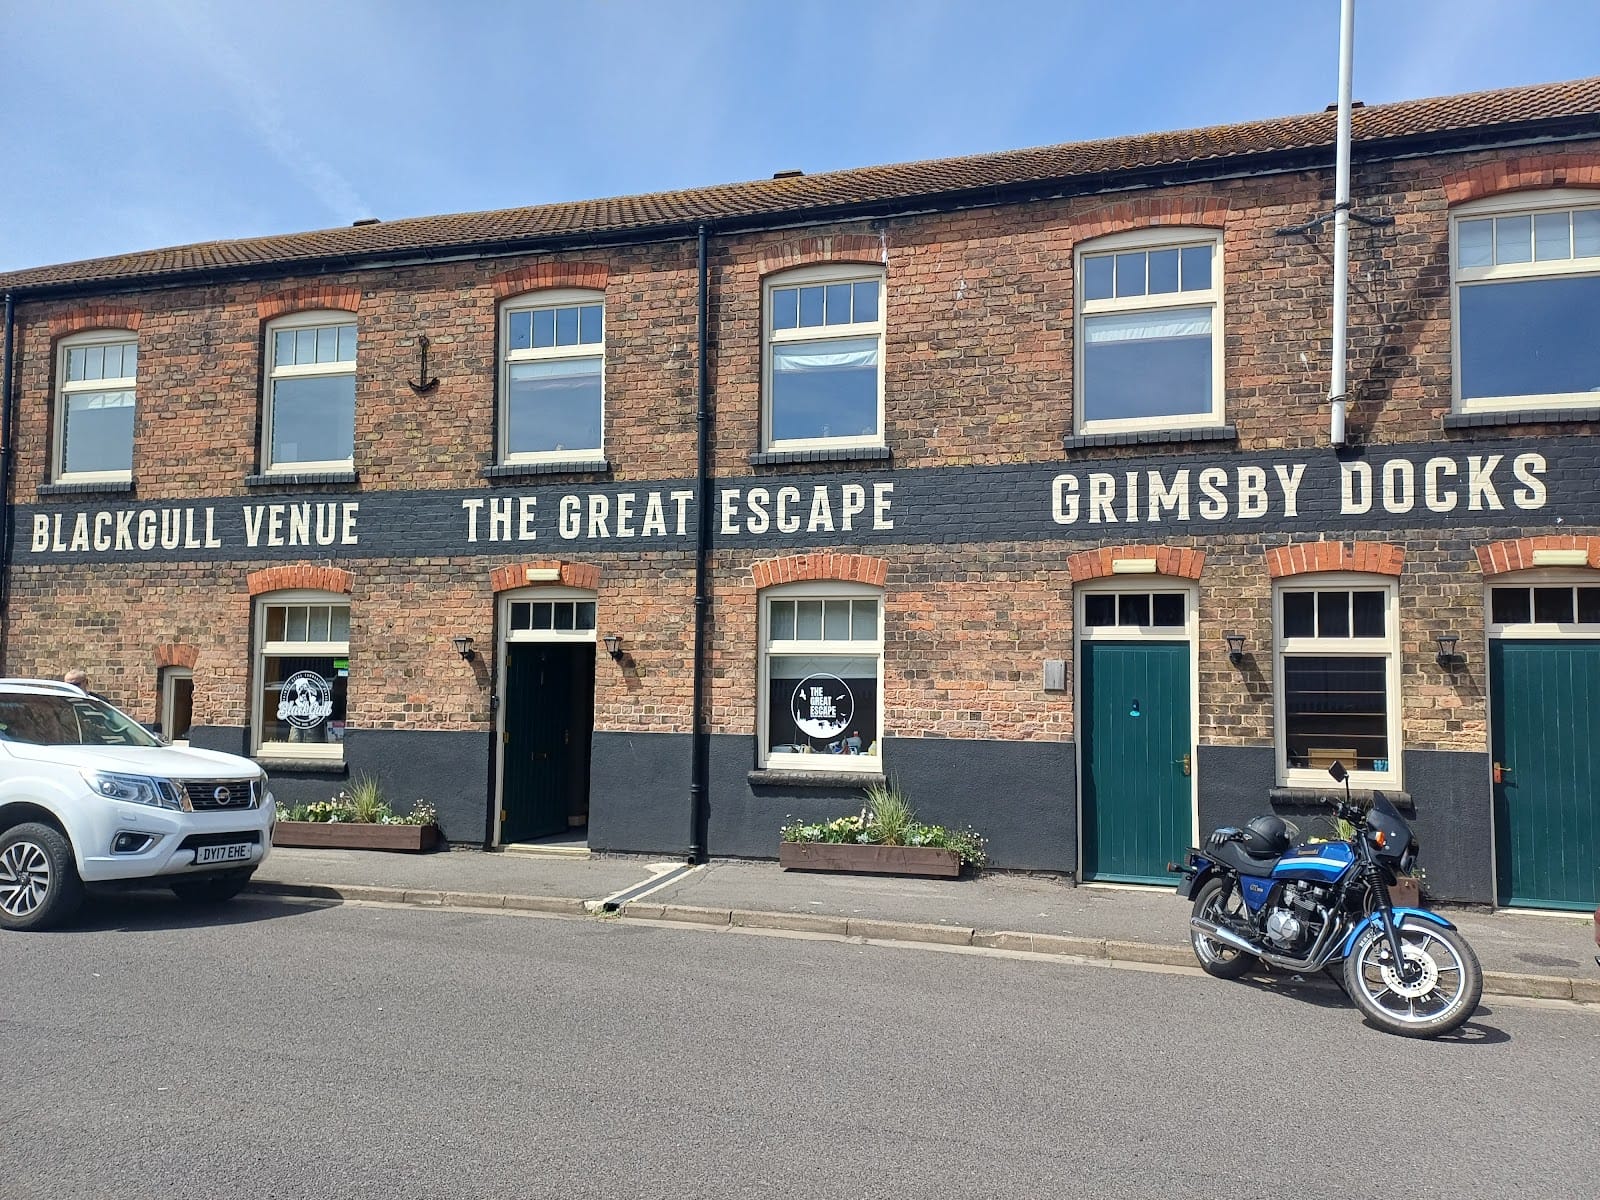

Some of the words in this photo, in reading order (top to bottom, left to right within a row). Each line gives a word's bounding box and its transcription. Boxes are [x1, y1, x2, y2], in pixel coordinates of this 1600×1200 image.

[1051, 464, 1307, 525] GRIMSBY
[1340, 453, 1548, 515] DOCKS
[462, 496, 537, 542] THE
[558, 491, 694, 540] GREAT
[720, 482, 894, 535] ESCAPE
[31, 507, 221, 552] BLACKGULL
[243, 502, 359, 547] VENUE
[810, 687, 824, 696] THE
[810, 696, 832, 706] GREAT
[810, 706, 837, 716] ESCAPE
[204, 847, 227, 861] DY17
[228, 845, 246, 858] EHE
